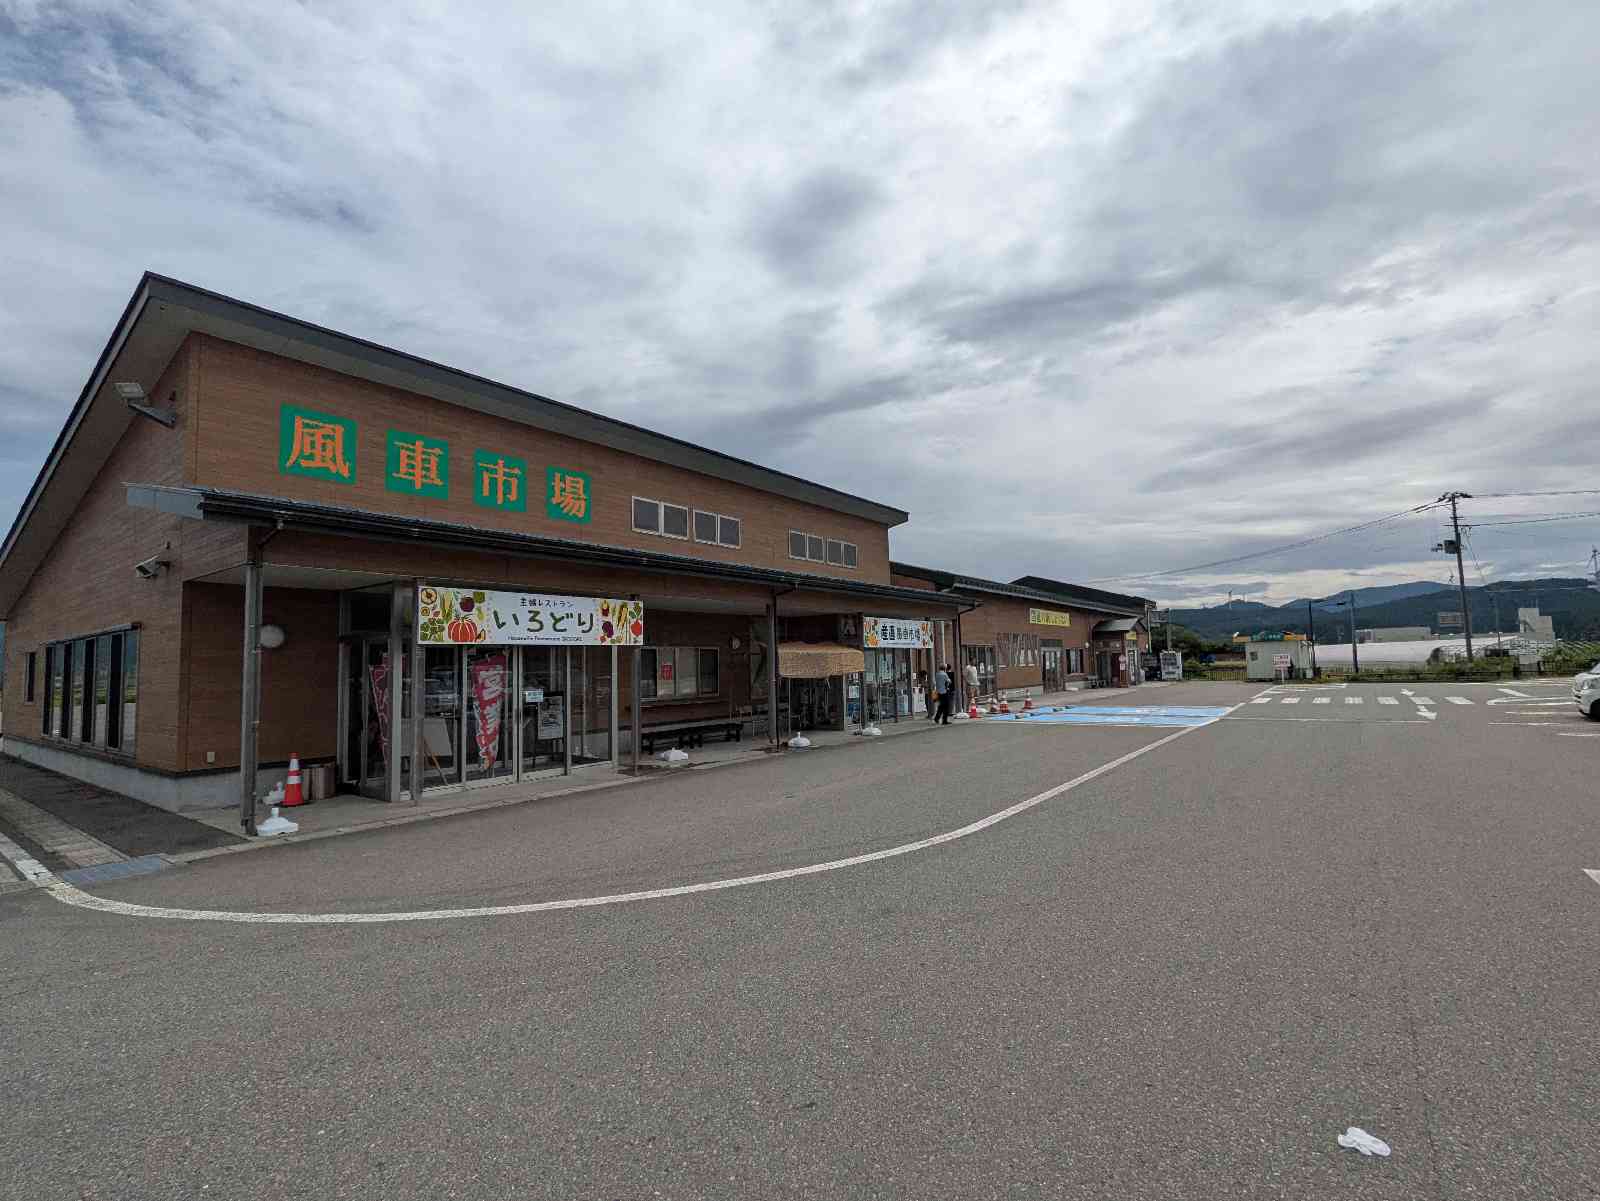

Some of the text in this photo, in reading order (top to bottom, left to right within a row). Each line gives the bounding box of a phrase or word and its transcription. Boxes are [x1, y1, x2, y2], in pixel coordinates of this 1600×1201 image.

[286, 415, 587, 518] 風車市場
[493, 610, 594, 634] いろどり
